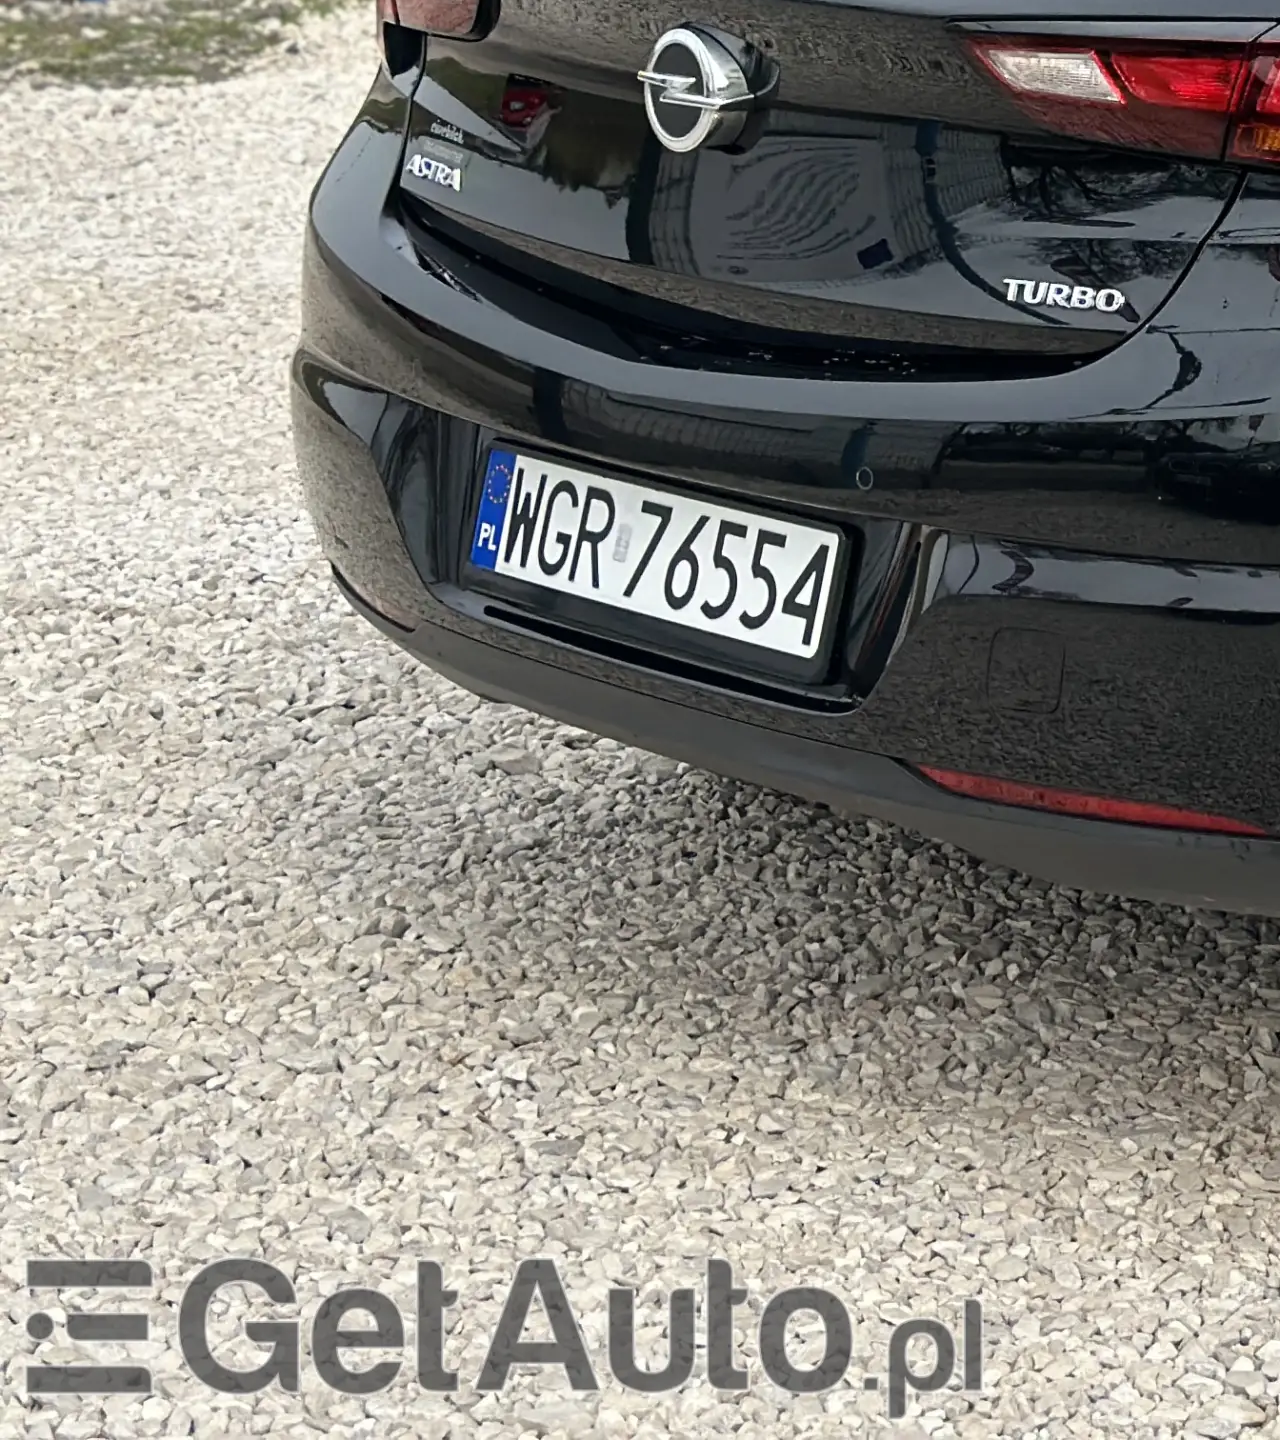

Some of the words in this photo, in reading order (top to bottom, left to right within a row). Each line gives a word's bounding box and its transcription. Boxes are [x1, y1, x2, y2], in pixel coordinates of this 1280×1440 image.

[405, 153, 461, 192] ASTRA
[1002, 278, 1125, 313] TURBO
[477, 522, 497, 552] PL
[503, 467, 616, 589] WGR
[622, 500, 831, 647] 76554
